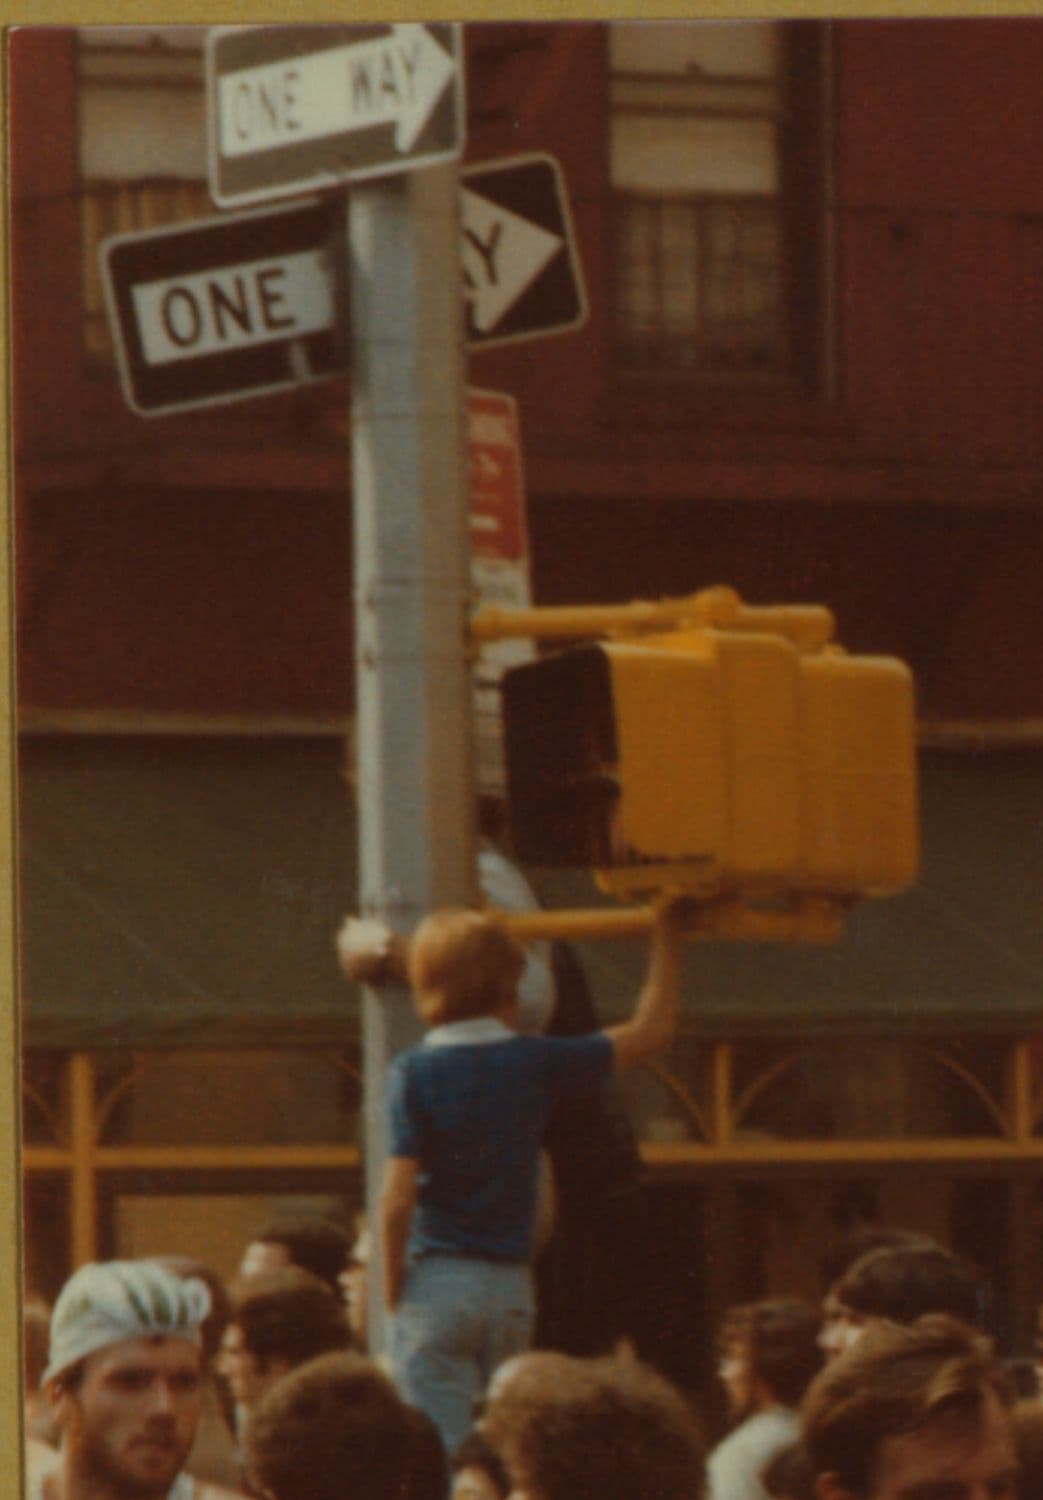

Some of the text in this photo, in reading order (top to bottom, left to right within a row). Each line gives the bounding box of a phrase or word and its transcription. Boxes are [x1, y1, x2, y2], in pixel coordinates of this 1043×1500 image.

[232, 42, 421, 142] ONE WAY
[160, 266, 296, 349] ONE
